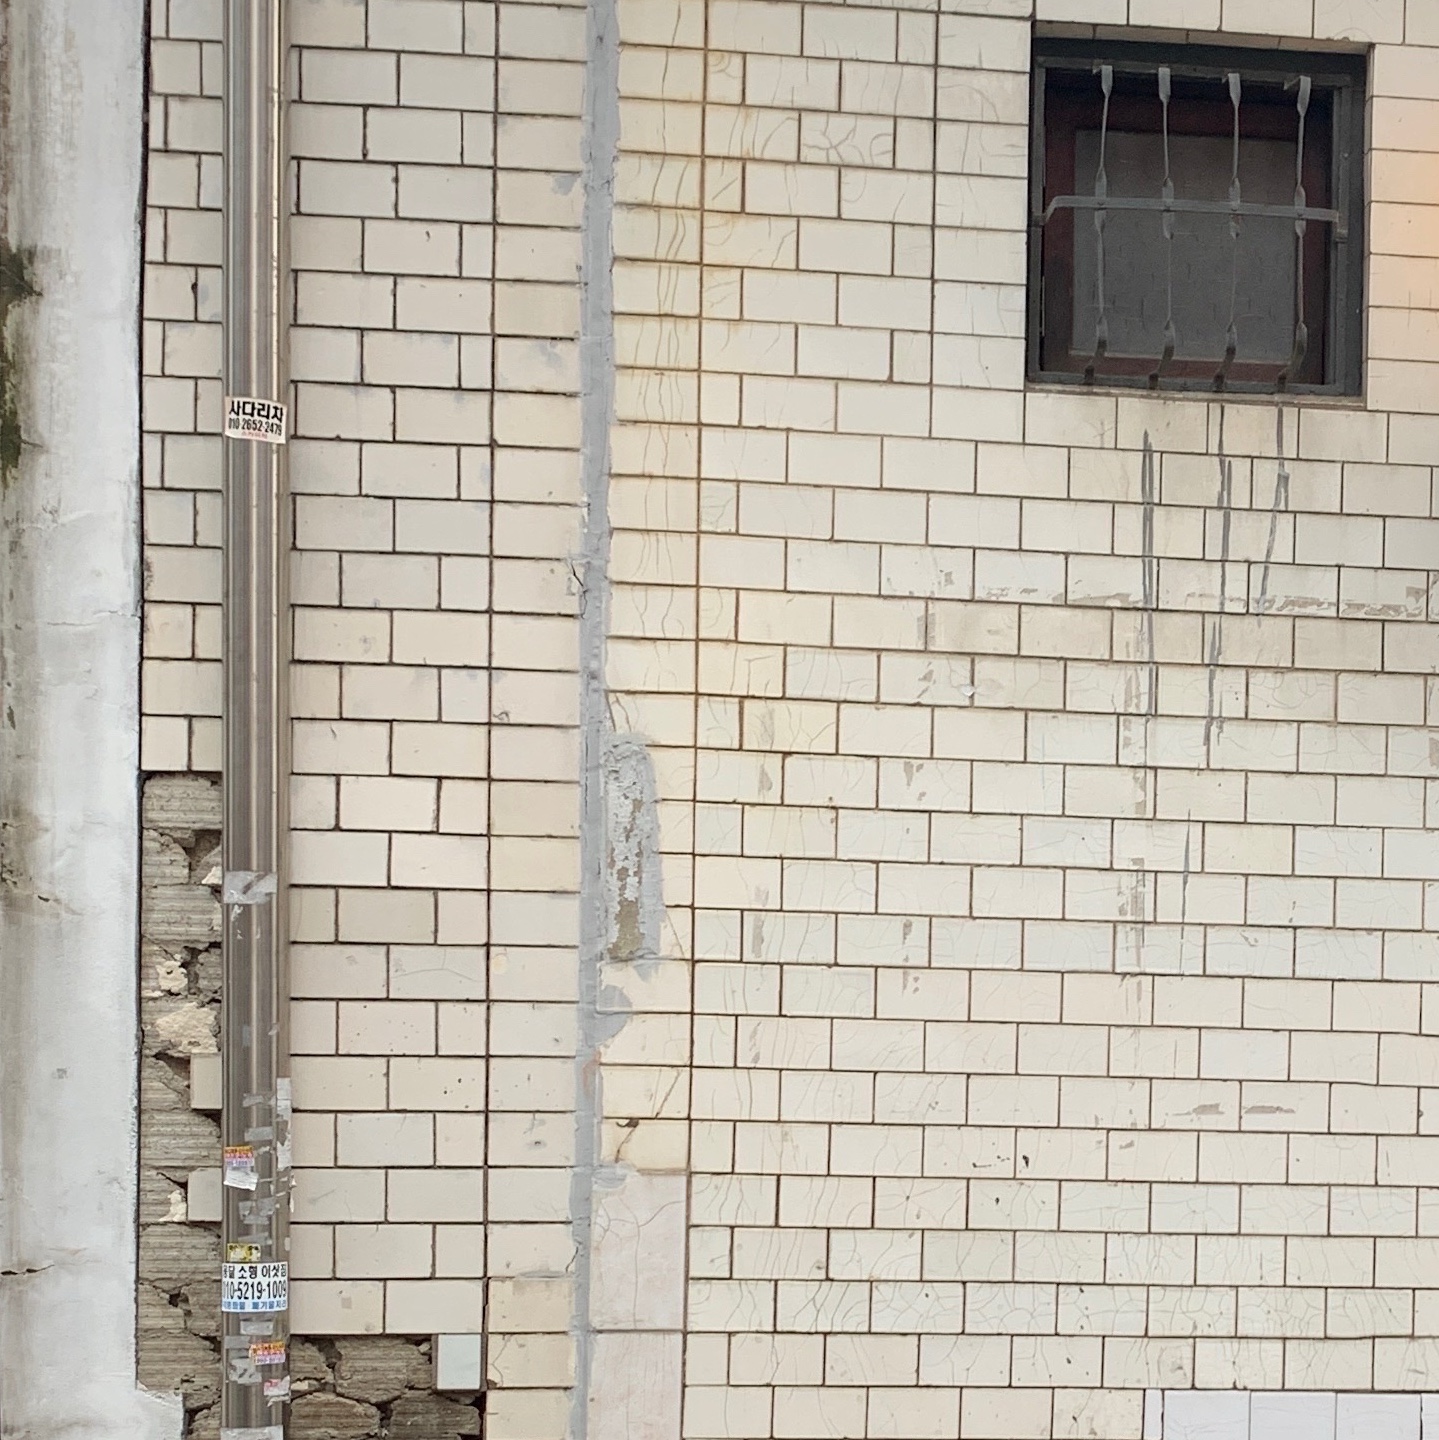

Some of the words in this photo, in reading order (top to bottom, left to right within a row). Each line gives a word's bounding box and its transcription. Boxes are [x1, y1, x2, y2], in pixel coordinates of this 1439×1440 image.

[238, 1265, 258, 1279] 소형
[261, 1263, 287, 1278] 이삿짐
[222, 1279, 287, 1300] 010-5219-1009
